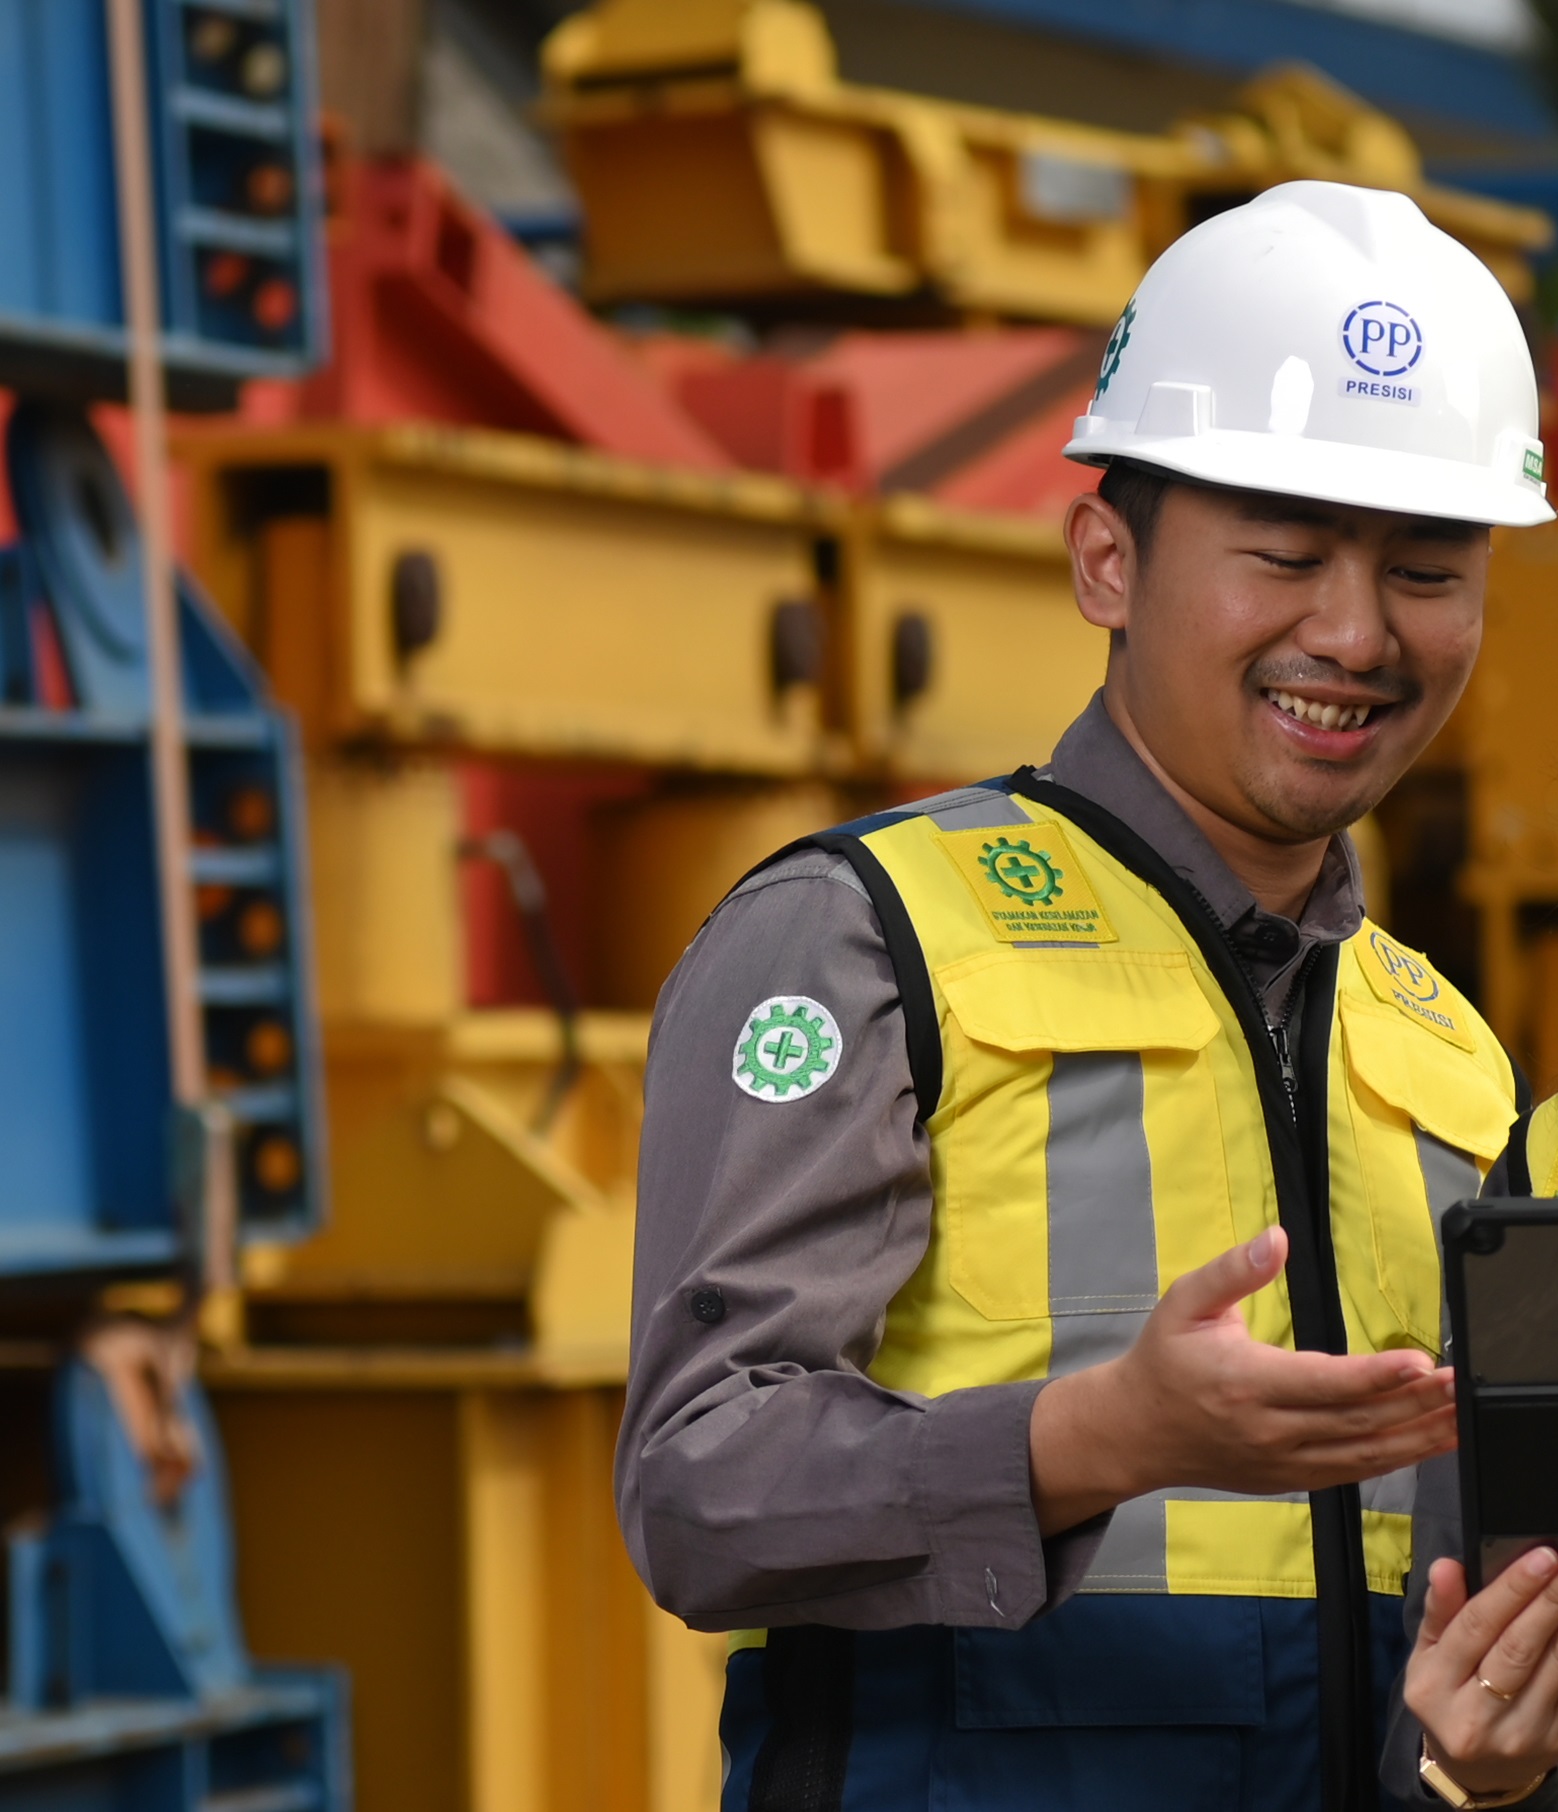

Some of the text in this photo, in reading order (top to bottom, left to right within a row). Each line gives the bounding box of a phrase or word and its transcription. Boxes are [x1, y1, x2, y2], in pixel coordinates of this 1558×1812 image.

[1358, 317, 1412, 358] PP
[1345, 379, 1413, 402] PRESISI
[1379, 941, 1422, 986] PP
[1392, 988, 1455, 1030] PRESISI
